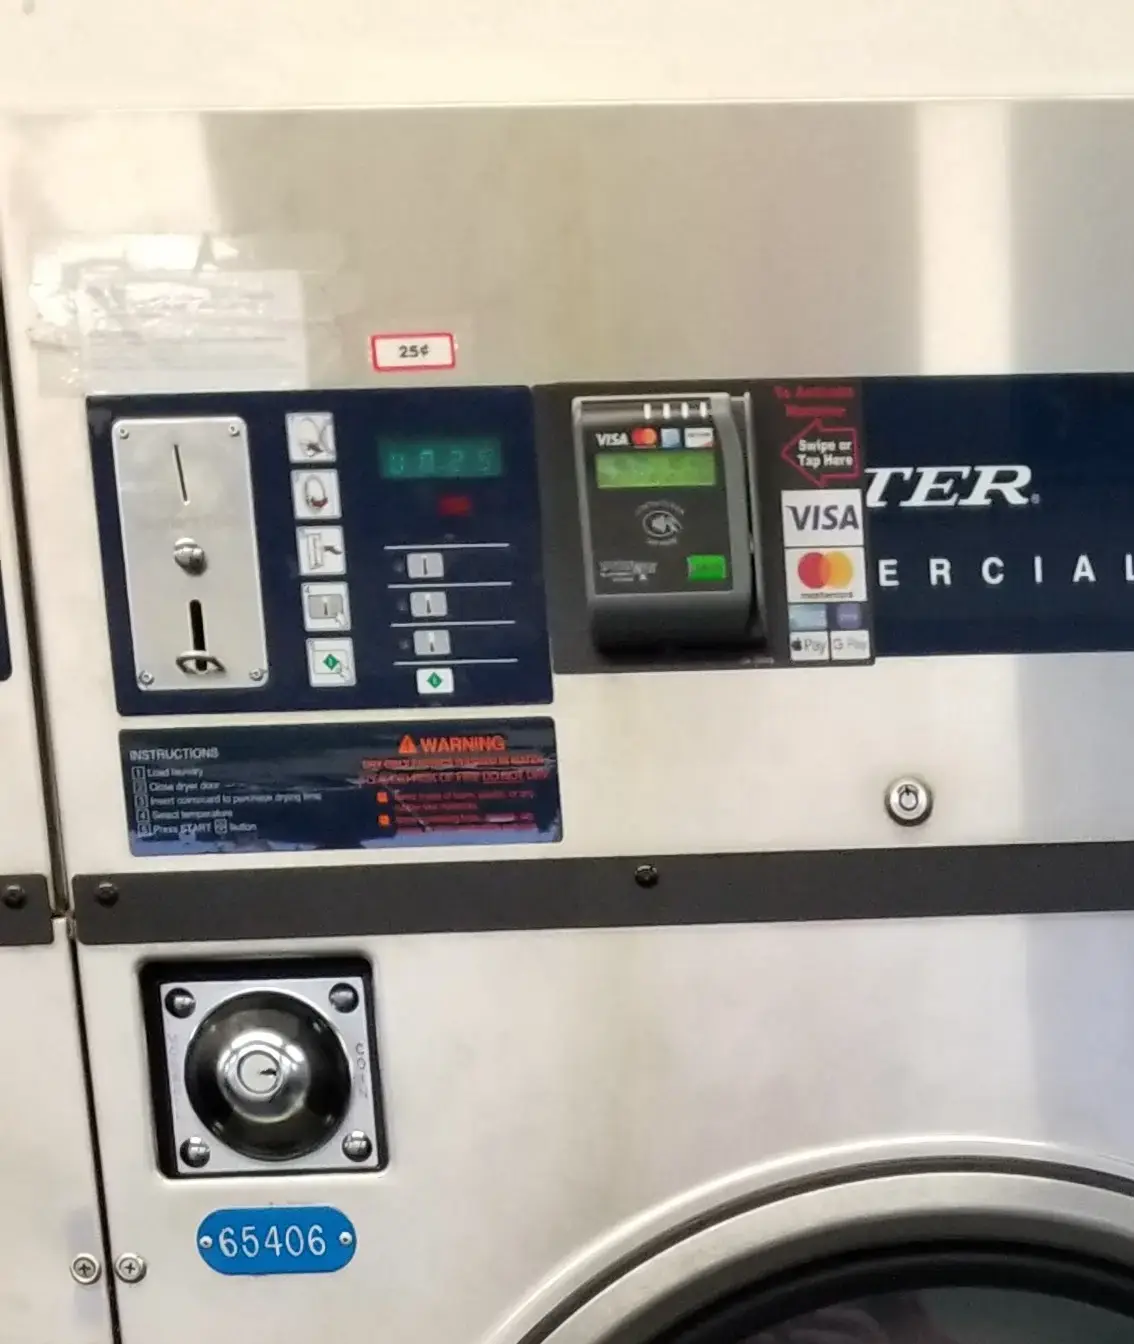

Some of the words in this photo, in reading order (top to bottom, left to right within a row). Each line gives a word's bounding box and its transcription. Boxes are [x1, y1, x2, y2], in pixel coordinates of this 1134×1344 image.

[398, 344, 430, 358] 25¢
[596, 432, 629, 446] VISA
[798, 439, 836, 454] Swipe
[838, 441, 852, 451] or
[797, 453, 821, 469] Tap
[823, 453, 853, 466] Here
[785, 504, 859, 531] VISA
[420, 735, 505, 753] WARNING
[130, 747, 219, 762] INSTRUCTIONS
[180, 821, 211, 833] START
[219, 1225, 326, 1258] 65406
